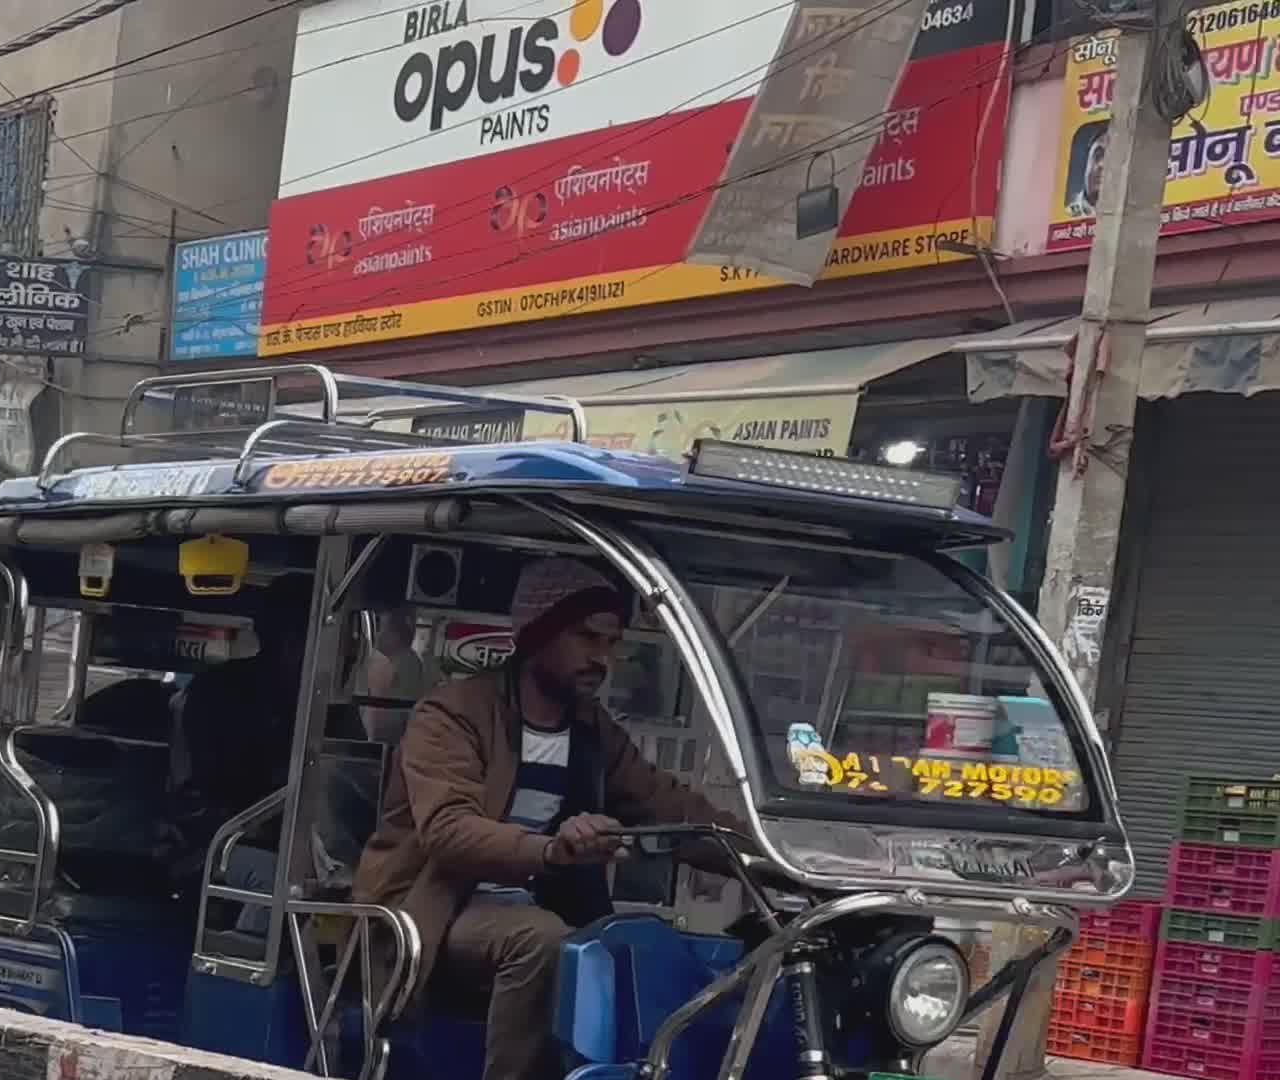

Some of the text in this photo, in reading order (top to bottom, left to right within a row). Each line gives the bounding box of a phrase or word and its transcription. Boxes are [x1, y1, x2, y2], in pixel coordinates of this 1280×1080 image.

[403, 0, 469, 44] BIRLA
[393, 17, 560, 131] opus
[480, 104, 550, 145] PAINTS
[181, 244, 220, 270] SHAH
[5, 262, 57, 282] शाह
[476, 298, 513, 317] GSTIN
[733, 417, 832, 442] ASIAN PAINTS
